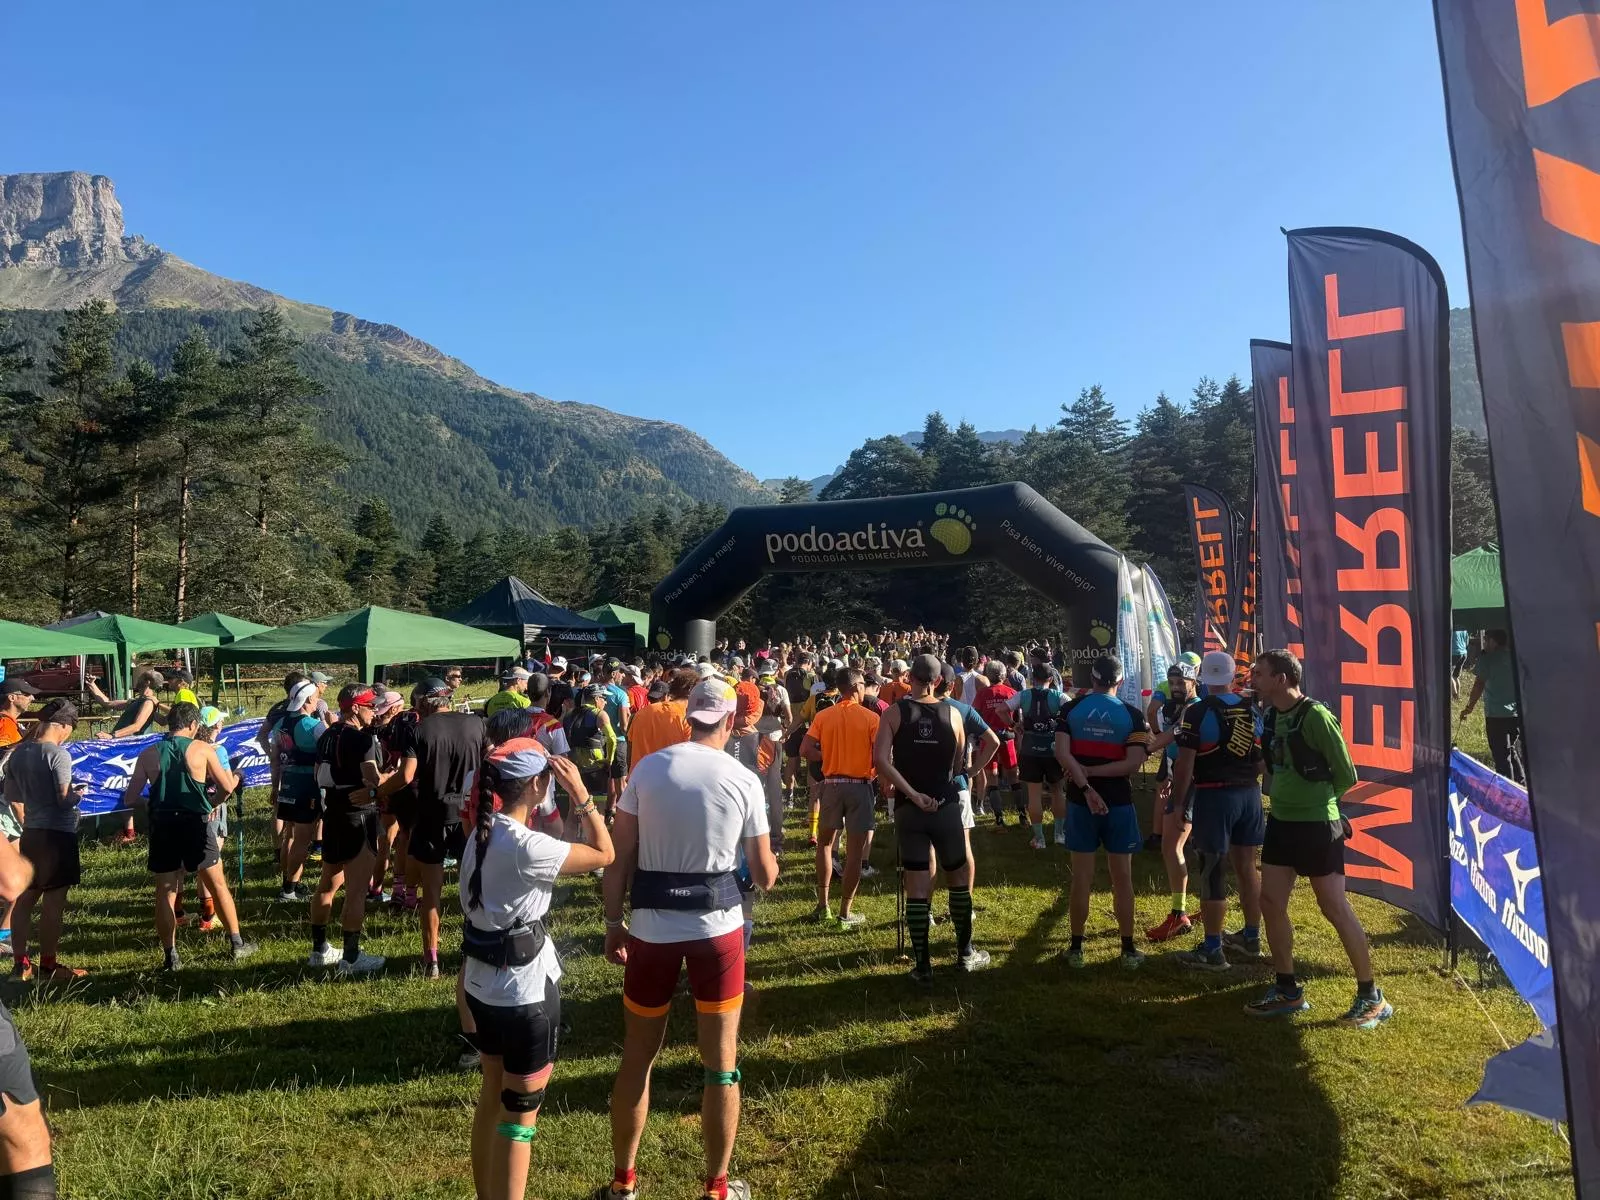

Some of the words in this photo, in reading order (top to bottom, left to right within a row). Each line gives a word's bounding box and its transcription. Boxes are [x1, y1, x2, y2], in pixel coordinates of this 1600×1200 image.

[664, 588, 683, 604] Pisa
[680, 573, 702, 590] bien,
[700, 557, 716, 573] vive
[715, 535, 737, 559] mejor
[766, 522, 925, 563] podoactiva
[1000, 520, 1021, 540] Pisa
[1021, 536, 1042, 558] bien,
[1046, 554, 1065, 572] vive
[1065, 569, 1096, 592] mejor
[1501, 897, 1548, 968] MIZUNO
